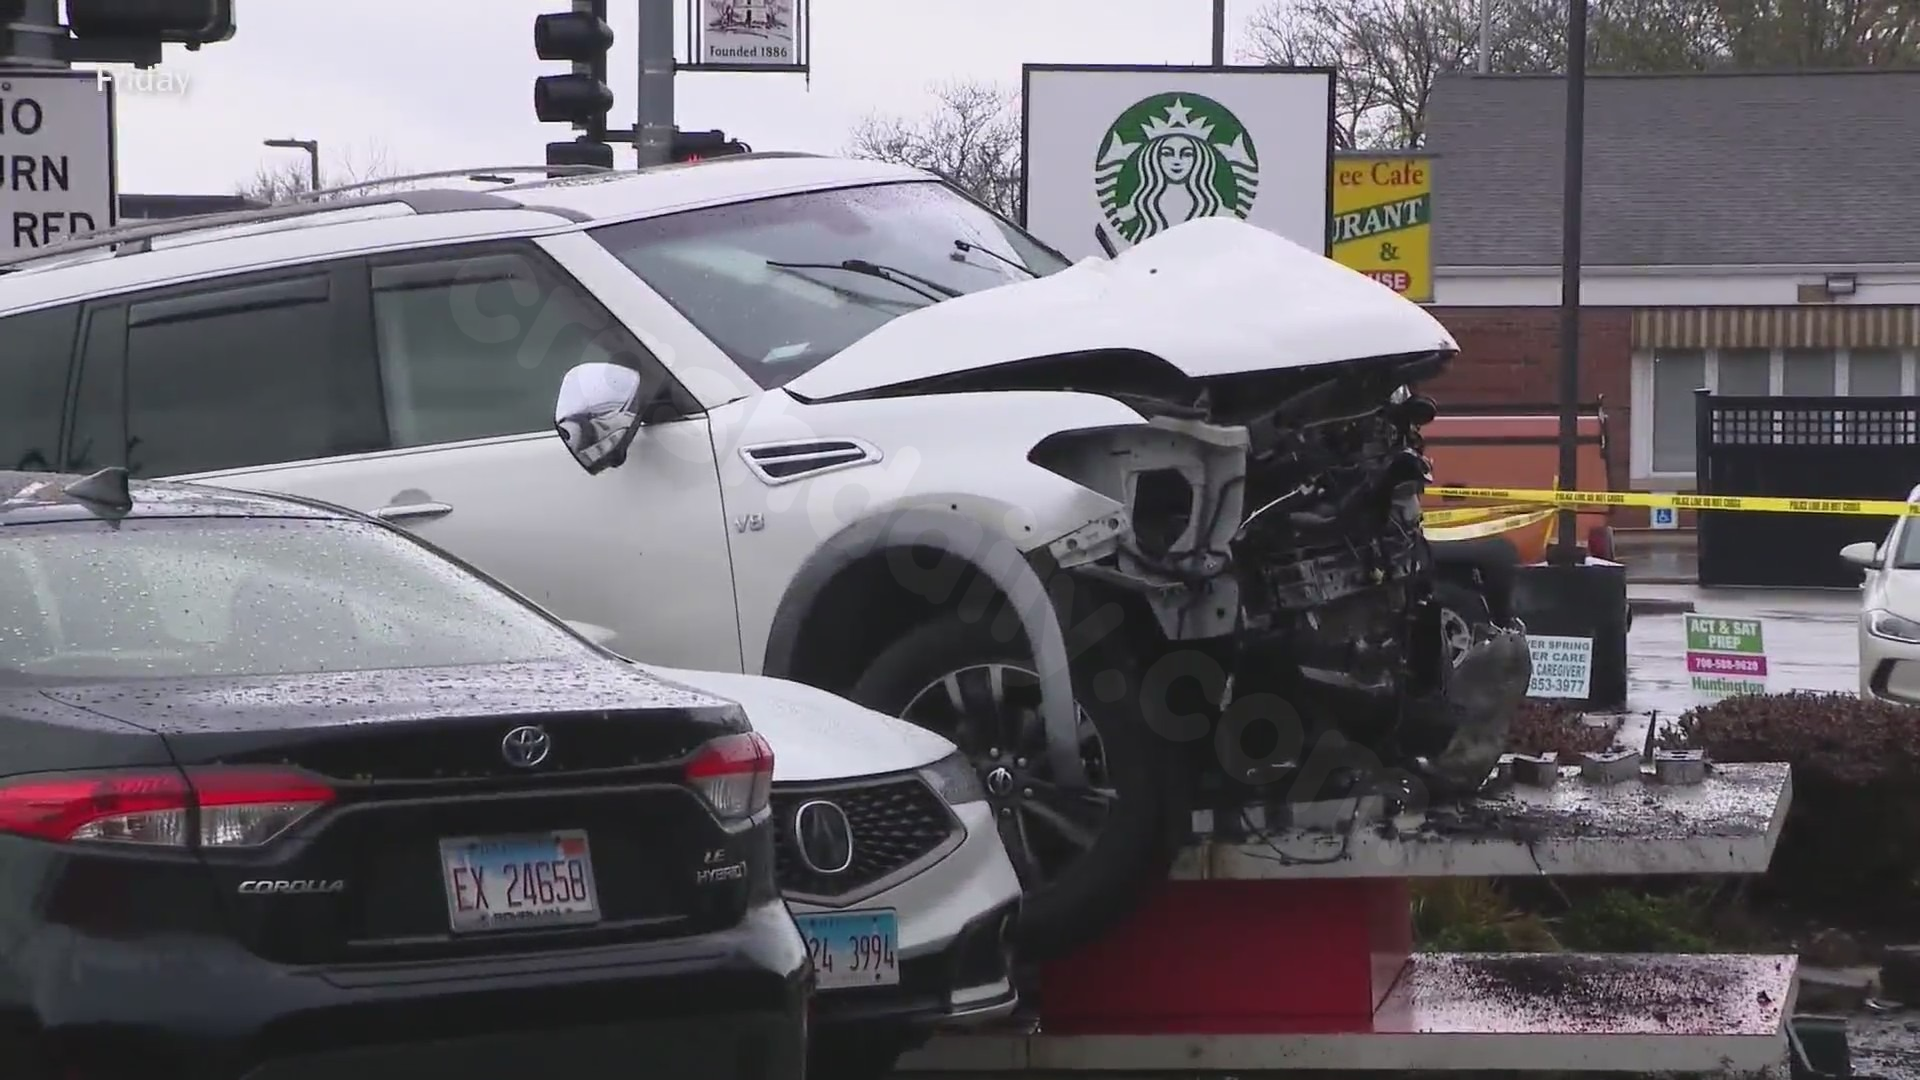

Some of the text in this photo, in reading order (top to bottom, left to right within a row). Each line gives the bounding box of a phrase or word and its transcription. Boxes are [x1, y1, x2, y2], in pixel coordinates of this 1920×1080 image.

[710, 45, 788, 58] Founded 1886
[0, 98, 43, 135] O
[0, 155, 69, 192] RN
[1371, 160, 1424, 187] Cafe
[1380, 242, 1400, 262] &
[735, 513, 765, 533] V8
[1691, 619, 1758, 637] ACT & SAT
[1548, 640, 1590, 651] SPRING
[1708, 634, 1742, 649] PREP
[1552, 652, 1586, 663] CARE
[1536, 664, 1586, 678] CAREGIVER?
[1692, 676, 1765, 694] Huntington
[704, 848, 725, 864] LE
[238, 880, 344, 894] COROLLA
[453, 859, 587, 912] EX 24658
[849, 932, 895, 972] 3994
